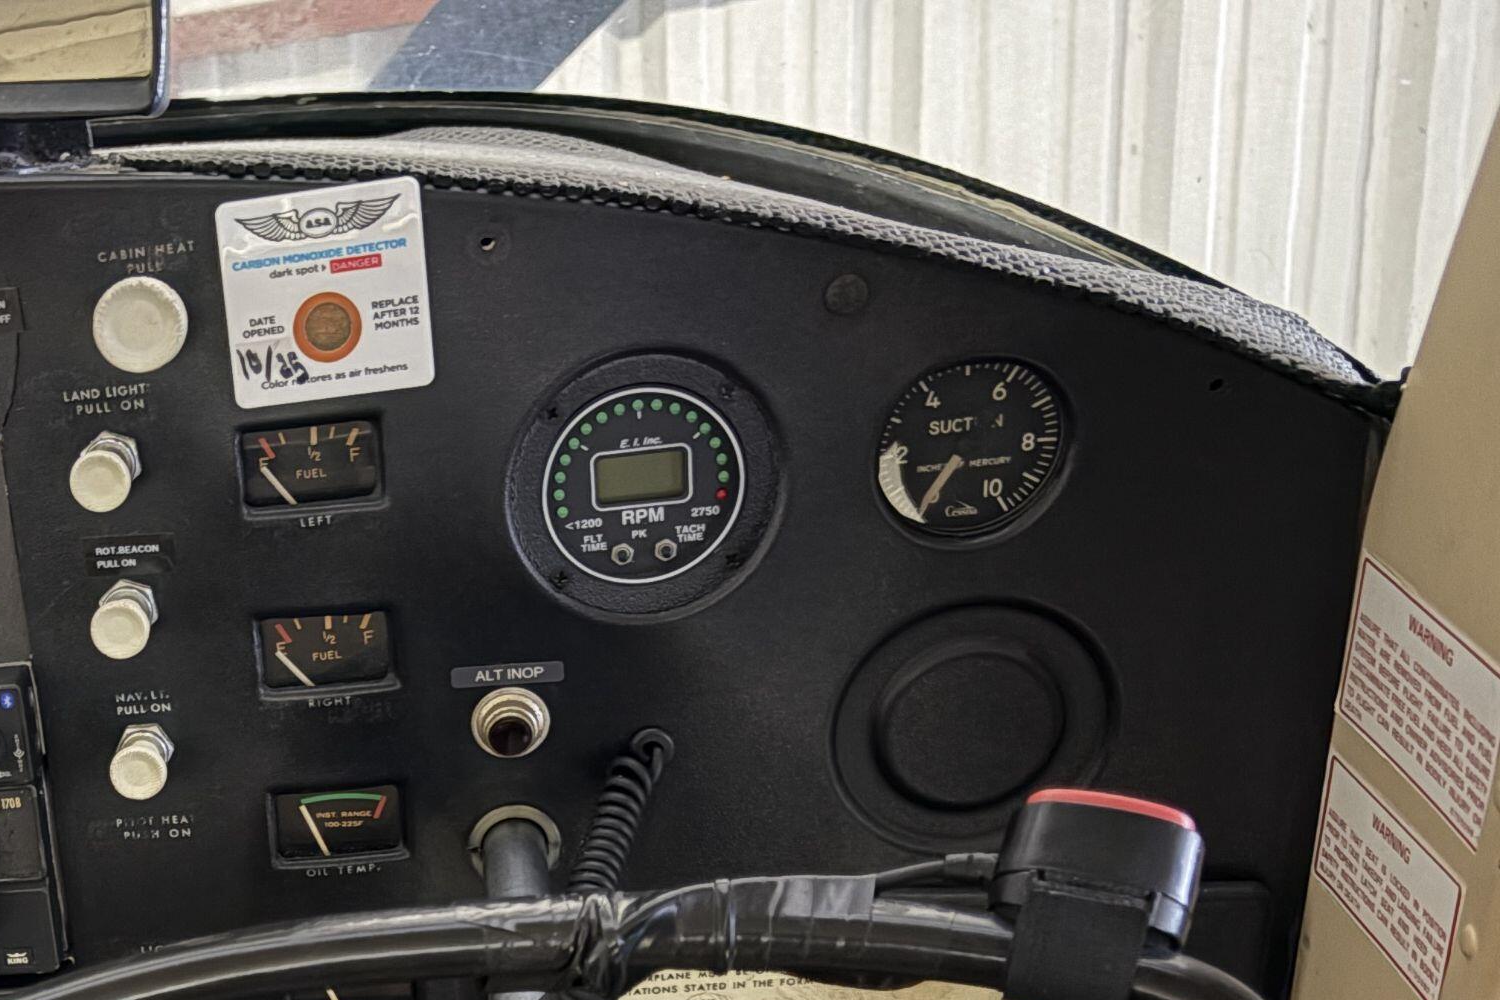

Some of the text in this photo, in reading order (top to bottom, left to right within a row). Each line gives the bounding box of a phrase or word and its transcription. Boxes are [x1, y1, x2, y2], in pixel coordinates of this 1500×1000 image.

[97, 240, 195, 263] CABIN HEAT
[232, 237, 407, 272] CARBON MONOXIDE DETECTOR
[269, 257, 379, 279] dark spot DANGER
[371, 295, 419, 310] REPLACE
[372, 306, 420, 320] AFTER 12
[249, 315, 276, 328] DATE
[374, 316, 420, 331] MONTHS
[242, 325, 285, 339] OPENED
[261, 362, 408, 390] Color as air freshens
[63, 383, 147, 403] LAND LIGHT
[991, 381, 1008, 401] 6
[76, 399, 145, 416] PULL ON
[928, 416, 974, 436] SUCT
[1020, 432, 1036, 452] 8
[968, 456, 1012, 468] MERCURY
[295, 468, 327, 480] FUEL
[982, 478, 1004, 499] 10
[621, 507, 666, 526] RPM
[690, 505, 720, 517] 2750
[300, 514, 332, 528] LEFT
[564, 517, 603, 531] <1200
[631, 529, 647, 539] PK
[674, 523, 706, 534] TACH
[583, 533, 604, 544] FLT
[677, 532, 705, 543] TIME
[95, 544, 159, 556] ROT.BEACON
[580, 541, 608, 553] TIME
[96, 557, 137, 570] PULL ON
[1408, 613, 1455, 668] WARNING
[312, 650, 342, 661] FUEL
[474, 666, 545, 683] ALT INOP
[116, 702, 171, 716] PULL ON
[308, 696, 352, 708] RIGHT
[1, 797, 22, 810] 170B
[168, 828, 191, 839] ON
[1371, 813, 1412, 866] WARNING
[306, 863, 382, 878] OIL TEMP.
[683, 979, 774, 993] STATED IN THE
